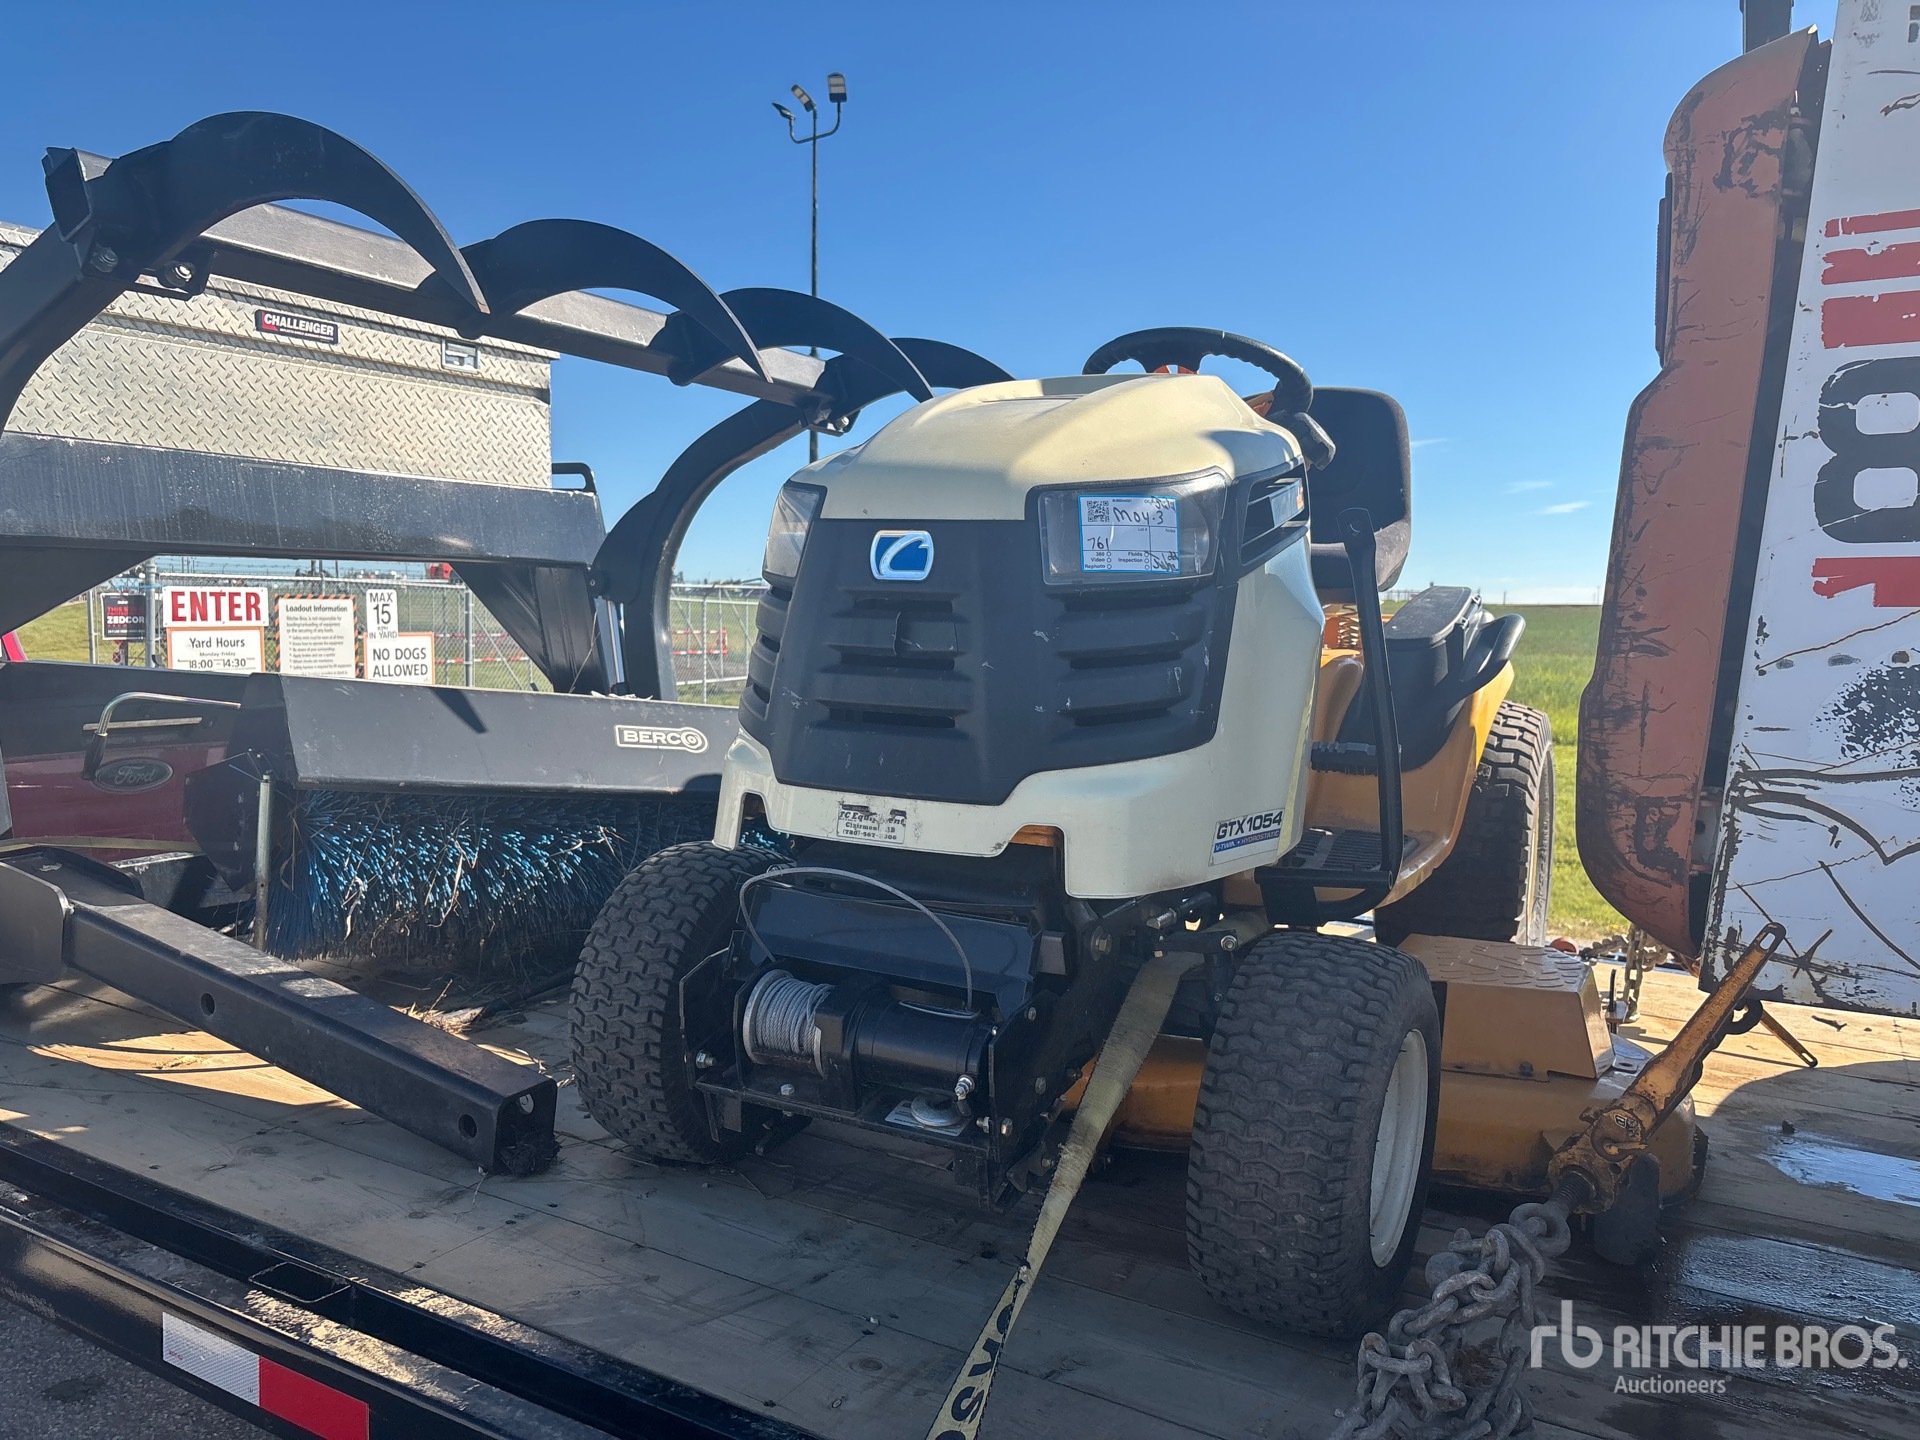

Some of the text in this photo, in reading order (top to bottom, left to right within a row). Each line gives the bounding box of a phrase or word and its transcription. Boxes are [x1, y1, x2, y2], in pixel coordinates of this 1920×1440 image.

[264, 313, 334, 336] CHALLENGER
[1087, 536, 1110, 550] 761
[369, 592, 393, 603] MAX
[171, 591, 262, 622] ENTER
[286, 604, 348, 612] Loadout Information
[107, 615, 145, 624] ZEDCOR
[373, 604, 391, 625] 15
[379, 631, 397, 639] YARD
[189, 637, 245, 648] Yard Hours
[373, 647, 427, 661] NO DOGS
[373, 664, 428, 677] ALLOWED
[623, 730, 703, 749] BERCO
[114, 766, 156, 785] Ford
[845, 822, 880, 831] Clairmon
[1216, 811, 1283, 839] GTX1054
[1215, 830, 1280, 851] V-TWIN HYDROSTATIC
